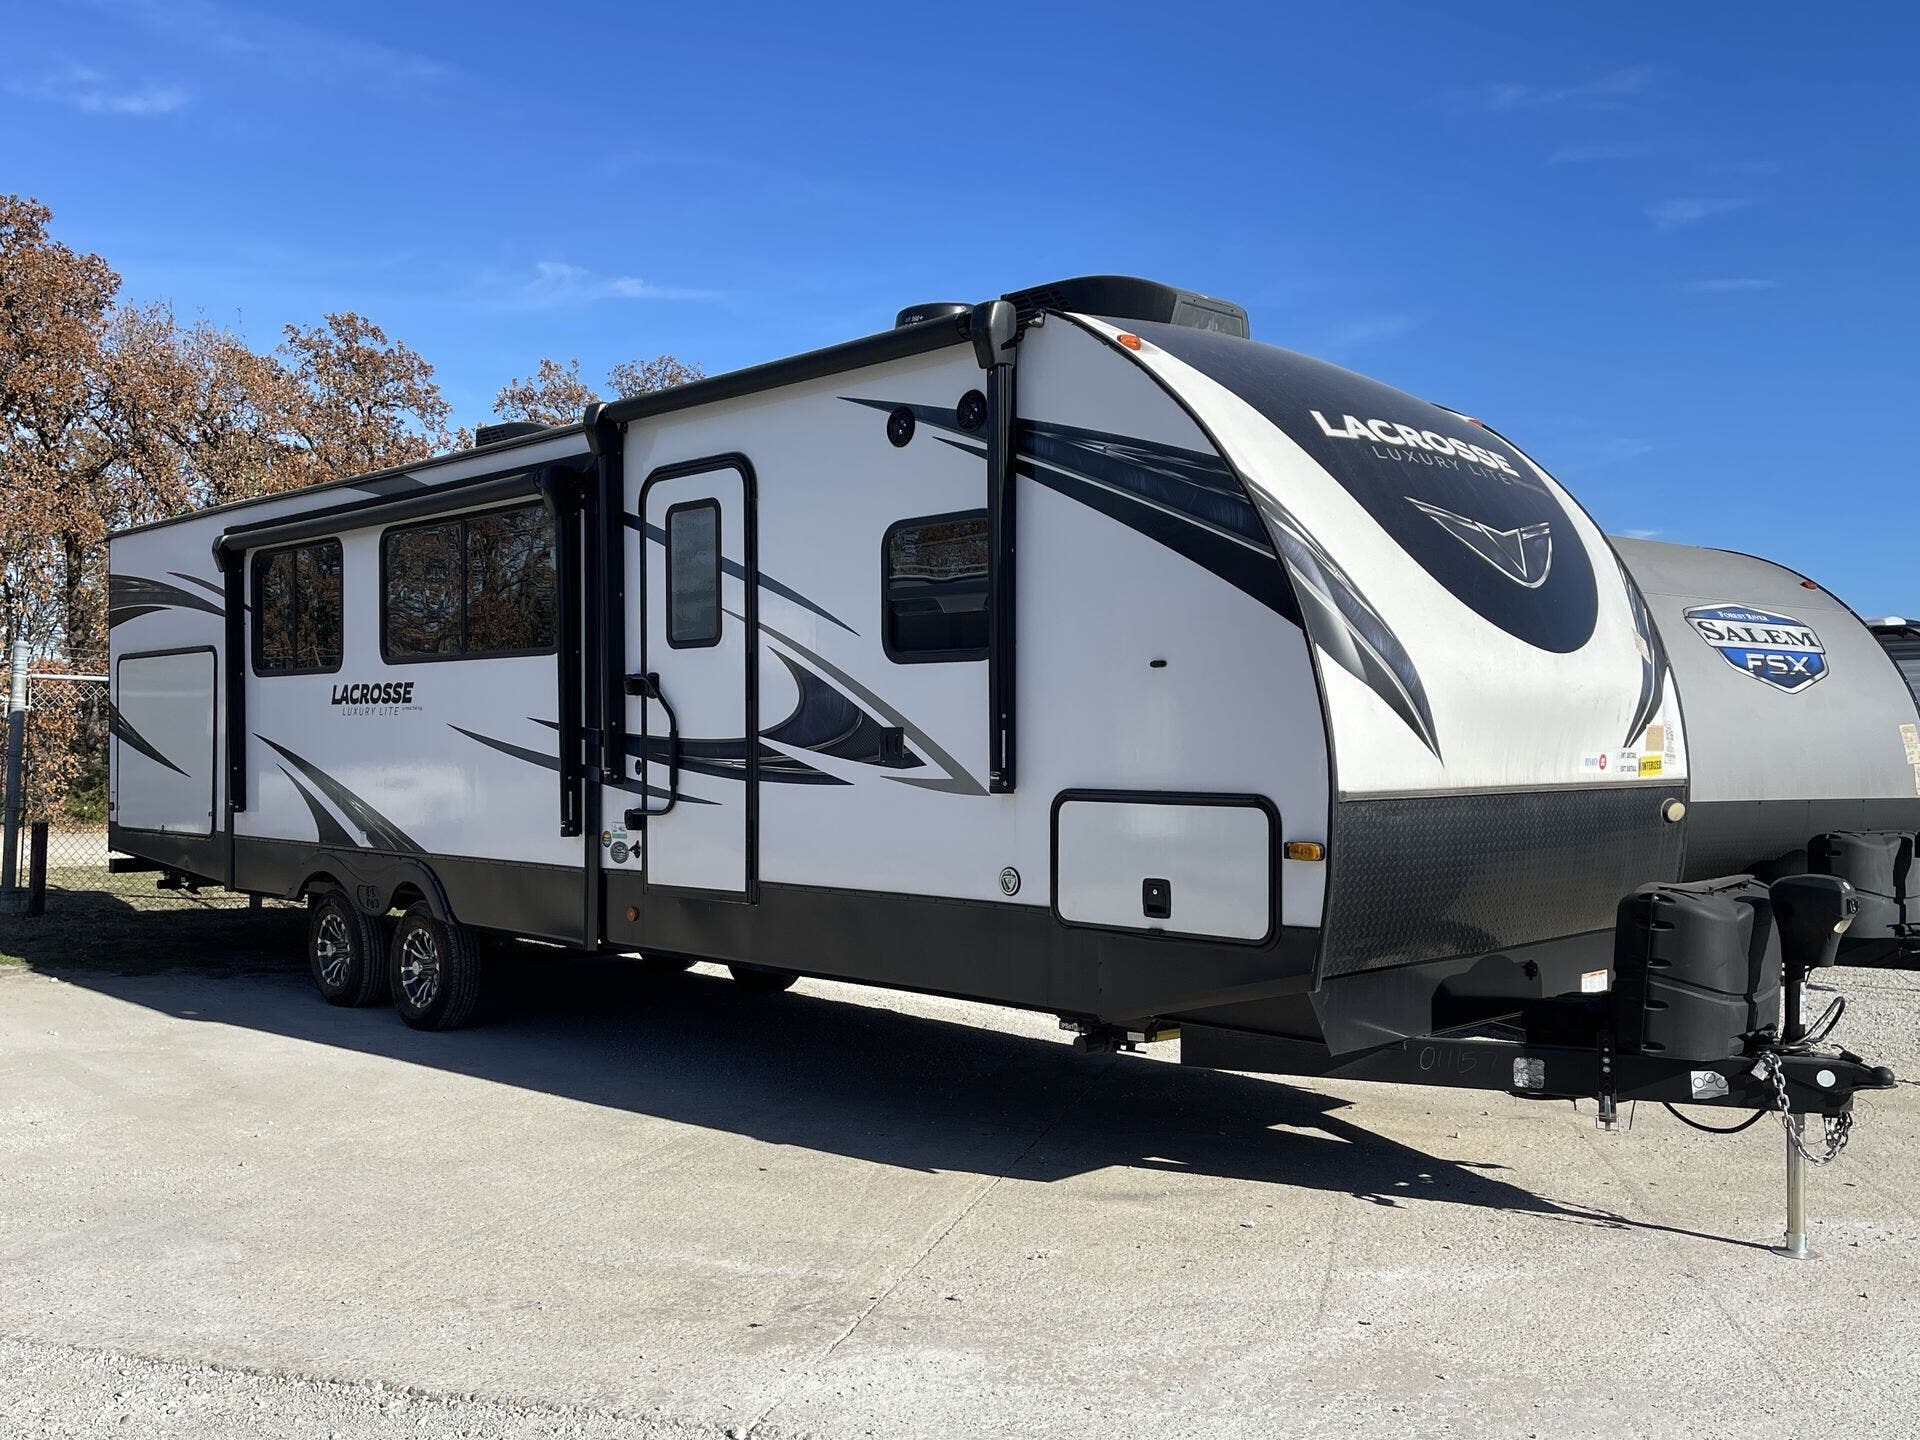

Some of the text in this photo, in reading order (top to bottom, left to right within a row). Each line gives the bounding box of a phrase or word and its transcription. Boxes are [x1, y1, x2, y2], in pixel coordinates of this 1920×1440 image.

[1309, 409, 1521, 477] LACROSSE
[1372, 446, 1512, 486] LUXURY LITE
[1696, 620, 1820, 648] SALEM
[1745, 653, 1812, 676] FSX
[331, 681, 415, 705] LACROSSE
[342, 706, 377, 717] LUXURY
[379, 706, 400, 716] LITE
